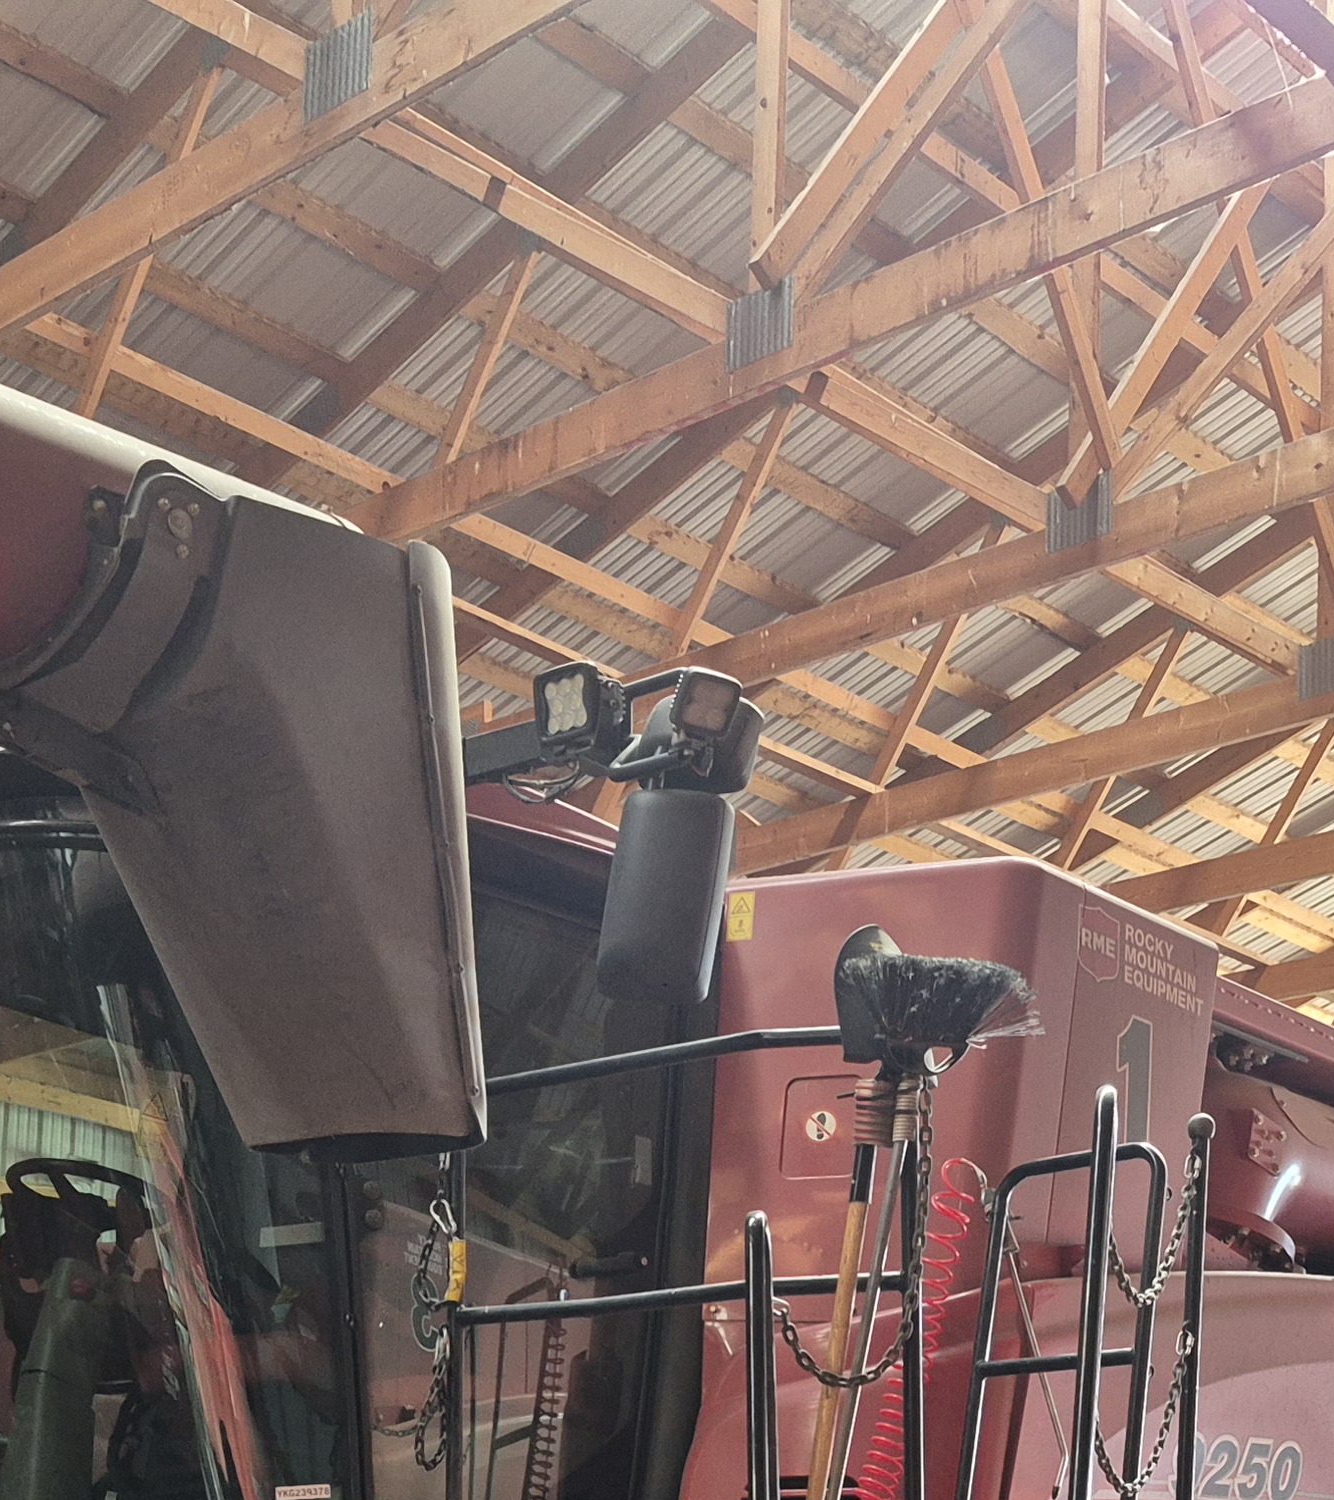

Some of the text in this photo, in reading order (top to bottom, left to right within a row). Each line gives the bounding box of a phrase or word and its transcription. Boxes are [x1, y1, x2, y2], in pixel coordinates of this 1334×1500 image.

[1081, 927, 1116, 959] RME
[1125, 923, 1174, 960] ROCKY
[1124, 944, 1196, 993] MOUNTAIN
[1124, 964, 1204, 1016] EQUIPMENT
[1116, 1014, 1153, 1144] 1
